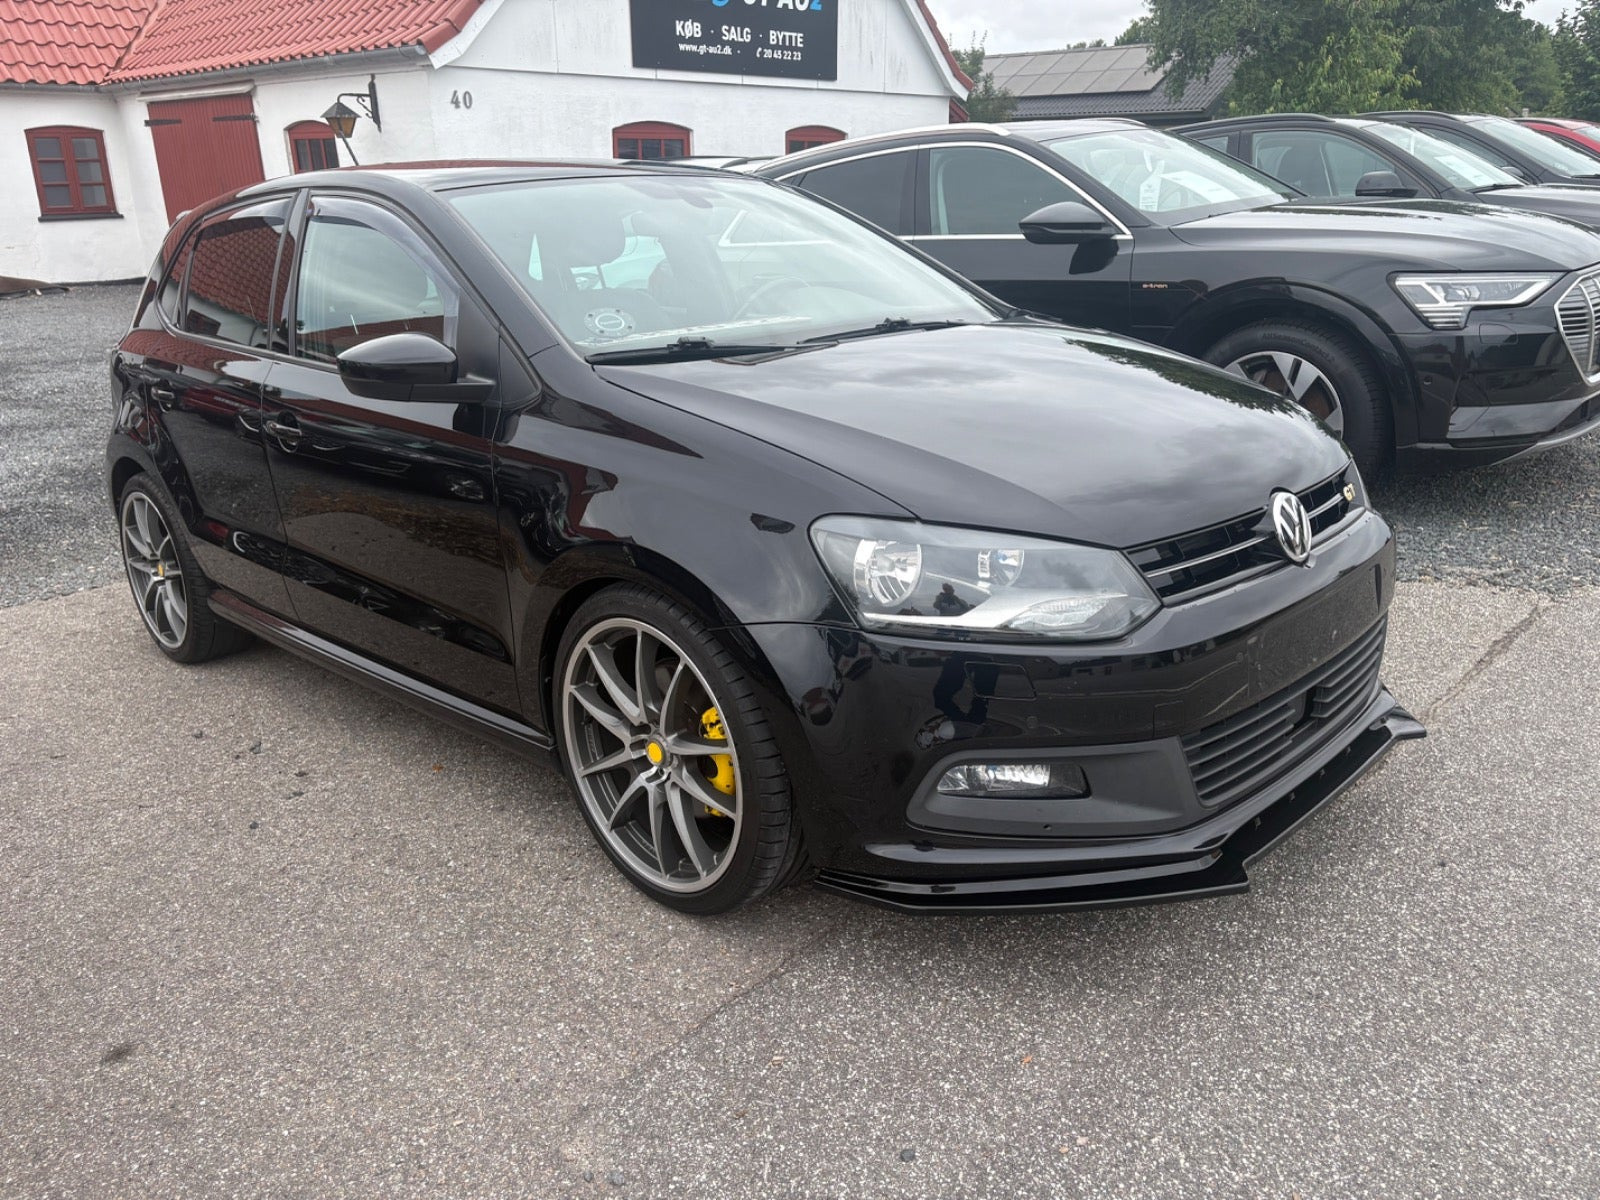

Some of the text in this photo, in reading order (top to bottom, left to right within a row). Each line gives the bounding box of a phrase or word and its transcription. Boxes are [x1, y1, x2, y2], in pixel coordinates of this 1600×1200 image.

[675, 19, 804, 47] KØB SALG BYTTE
[678, 43, 802, 61] www.gt-au2.dk 20 45 22 23
[450, 89, 473, 110] 40
[1342, 483, 1356, 502] GT
